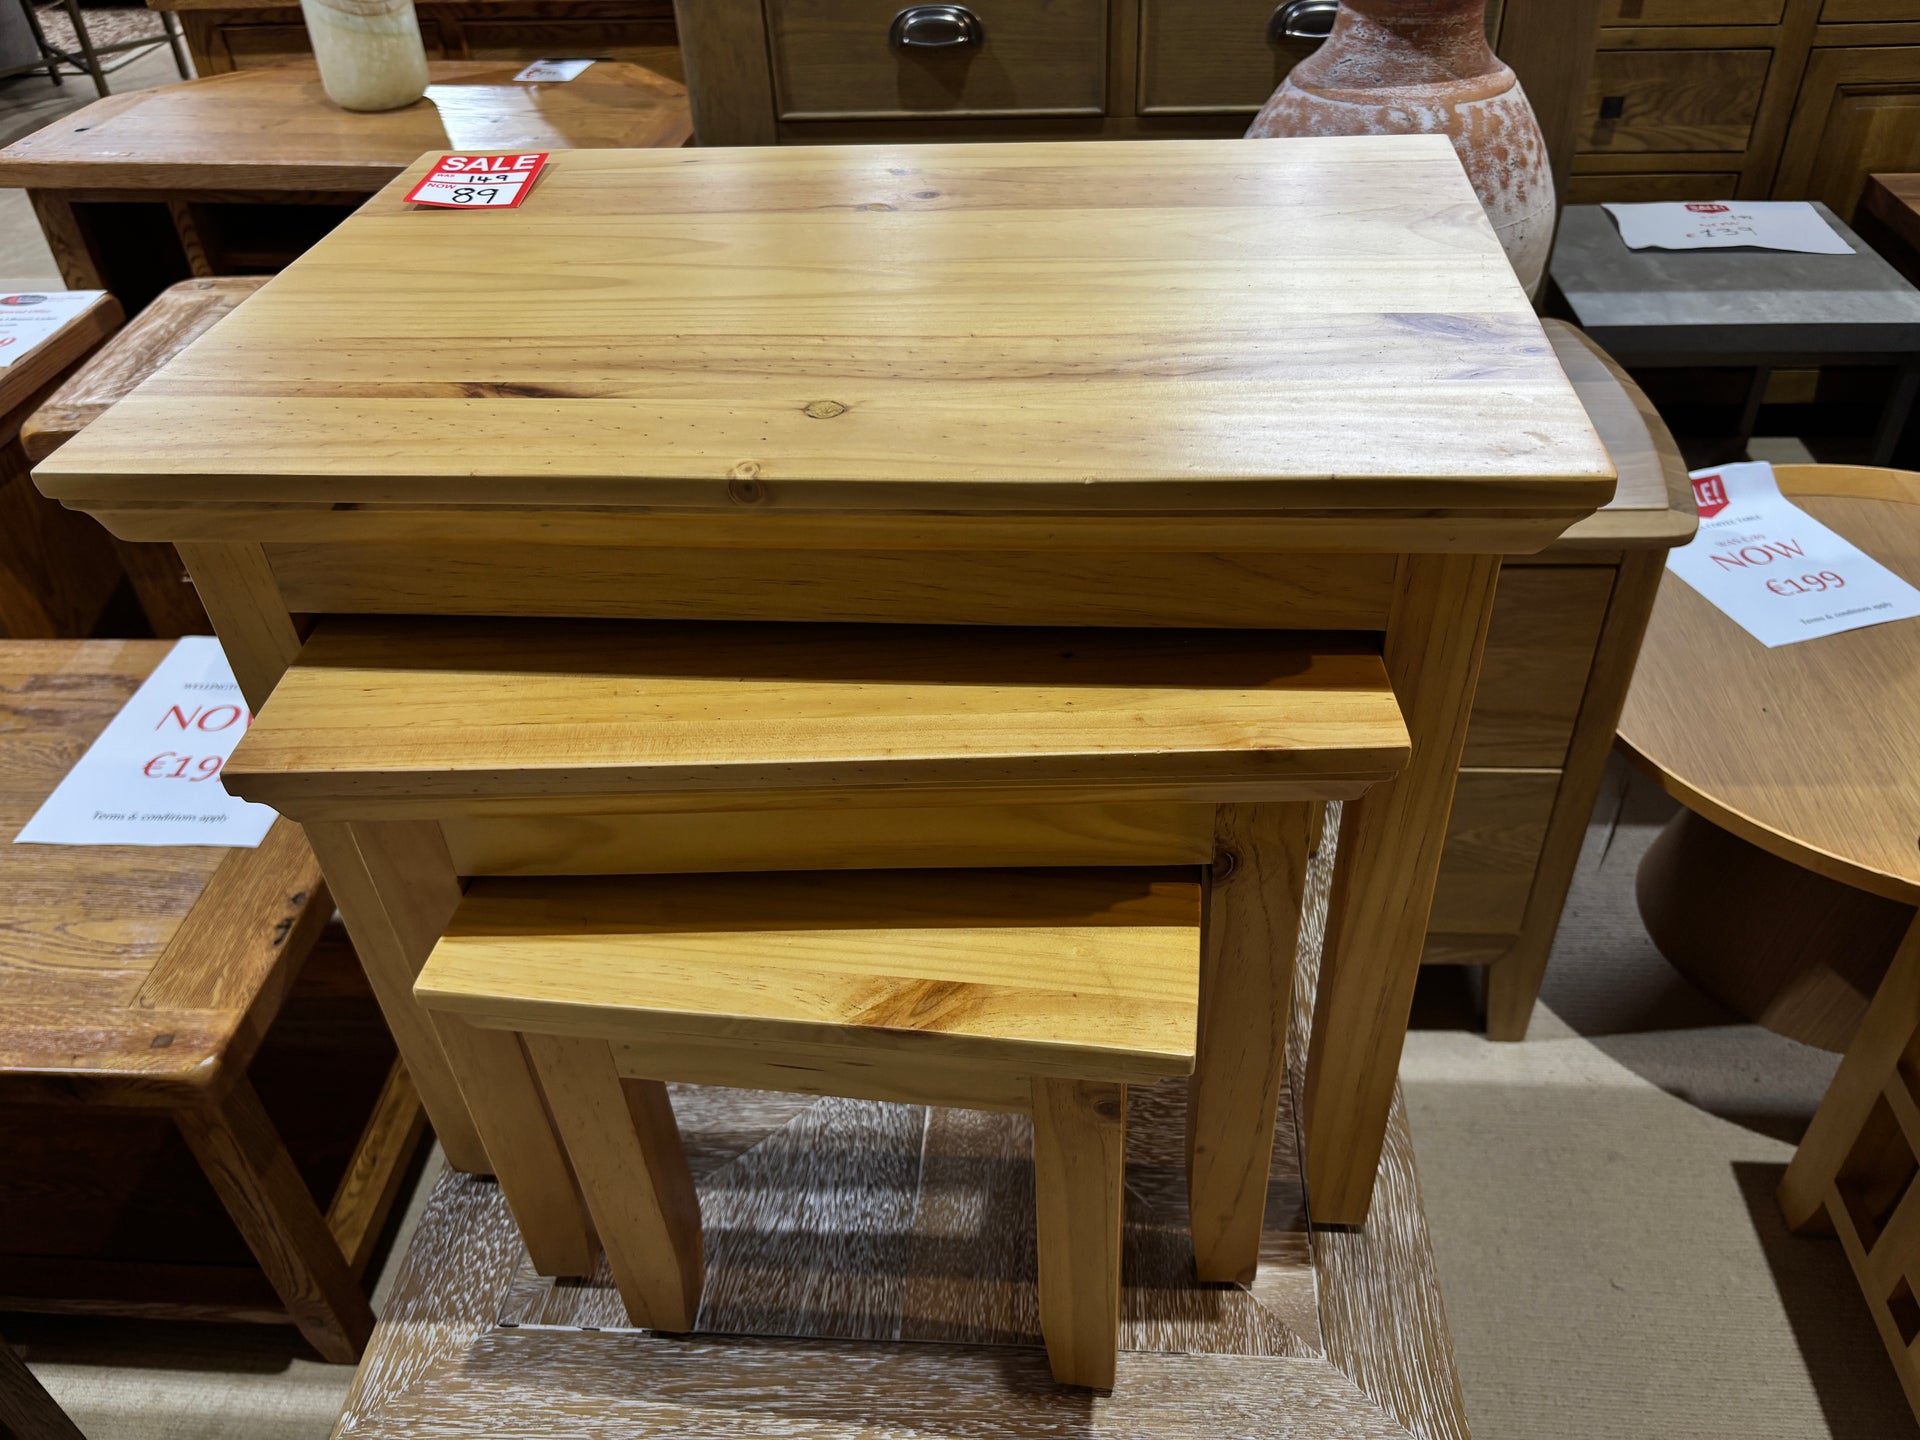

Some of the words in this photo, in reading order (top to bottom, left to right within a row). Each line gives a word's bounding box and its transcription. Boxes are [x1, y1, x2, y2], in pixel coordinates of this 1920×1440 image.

[441, 155, 539, 171] SALE
[469, 174, 508, 183] 149
[452, 187, 499, 204] 89
[1692, 479, 1723, 507] LE!
[1710, 539, 1804, 571] NOW
[1766, 571, 1845, 596] €199
[143, 752, 223, 782] €19
[93, 810, 125, 820] Terms
[128, 812, 138, 820] &
[141, 812, 197, 821] conditions
[199, 812, 228, 823] apply
